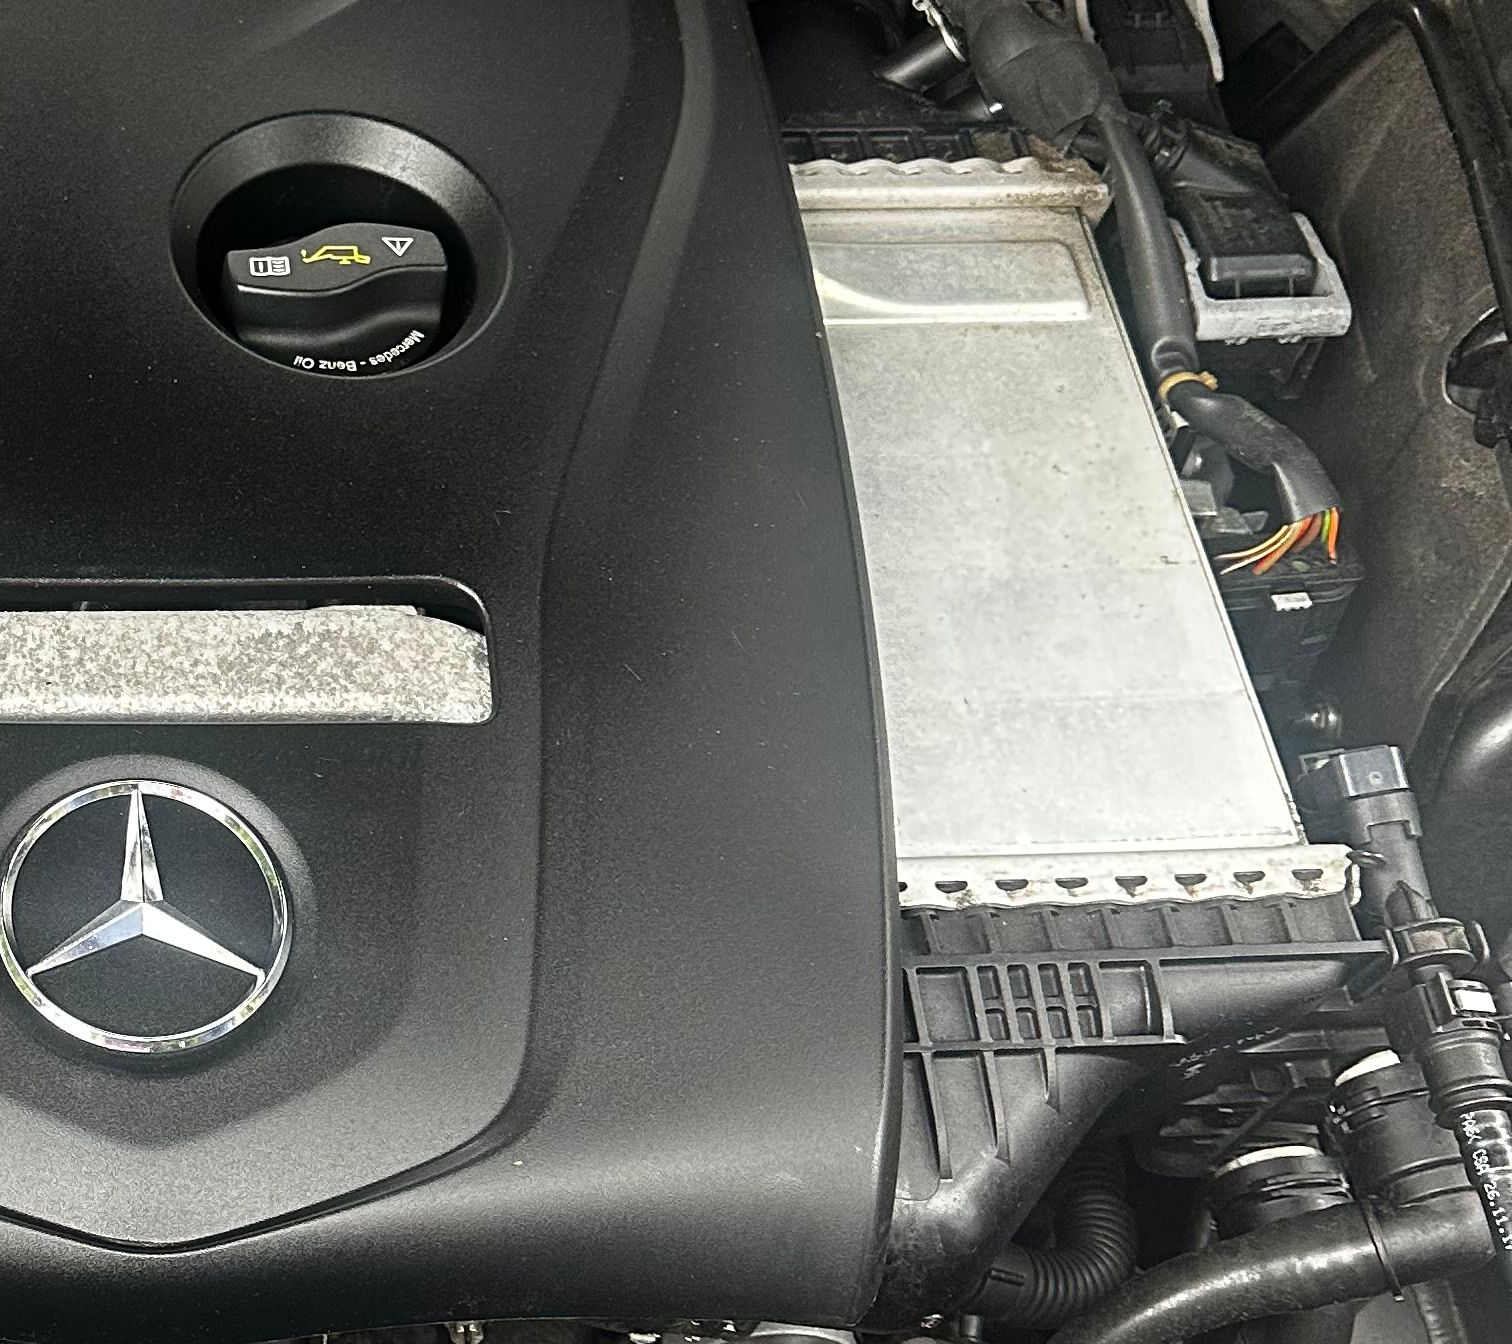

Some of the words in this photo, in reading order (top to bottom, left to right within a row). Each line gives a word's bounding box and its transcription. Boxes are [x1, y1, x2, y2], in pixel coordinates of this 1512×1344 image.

[369, 330, 425, 365] Mercedes
[293, 356, 315, 370] Oil
[318, 359, 357, 371] Benz
